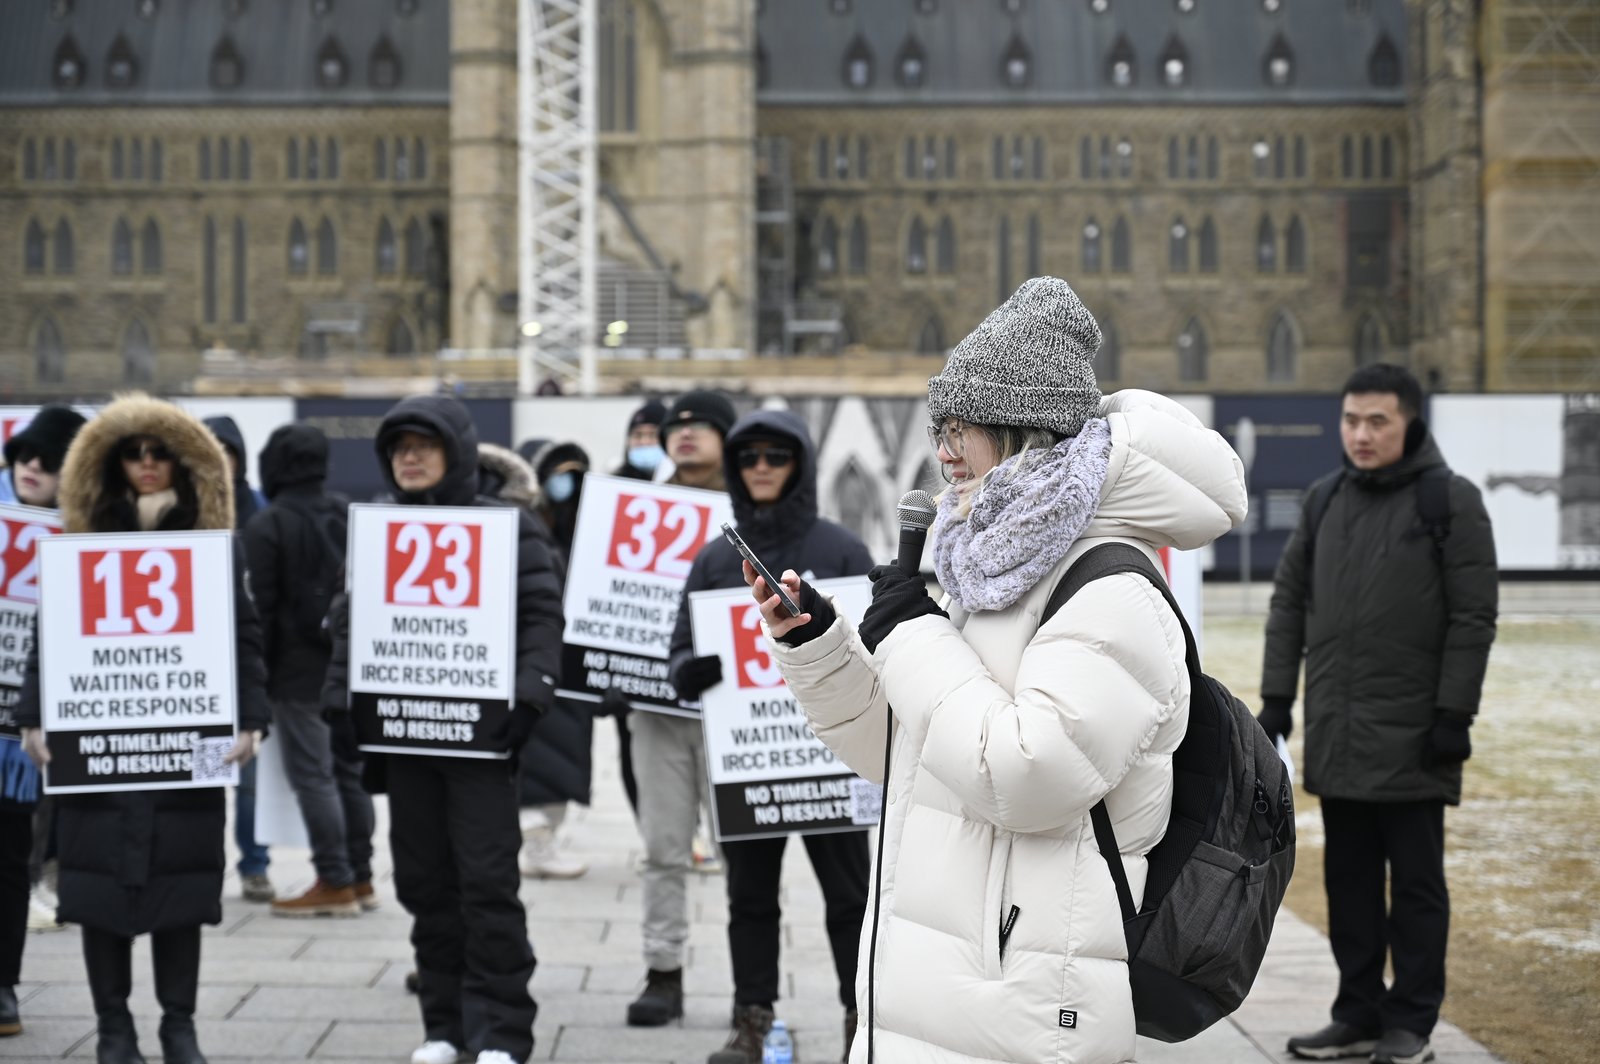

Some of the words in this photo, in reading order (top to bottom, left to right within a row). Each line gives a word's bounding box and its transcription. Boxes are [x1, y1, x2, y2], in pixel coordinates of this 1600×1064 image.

[616, 496, 700, 578] 32
[0, 517, 50, 598] 2
[393, 522, 472, 607] 23
[94, 549, 179, 634] 13
[588, 598, 661, 624] WAITING
[391, 617, 468, 636] MONTHS
[571, 618, 610, 638] IRCC
[614, 624, 672, 649] RESPO
[92, 646, 183, 666] MONTHS
[372, 640, 446, 660] WAITING
[453, 644, 488, 662] FOR
[361, 664, 398, 683] IRCC
[402, 667, 498, 688] RESPONSE
[583, 650, 608, 670] NO
[608, 654, 669, 680] TIMELIN
[70, 673, 159, 692] WAITING
[167, 671, 206, 689] FOR
[586, 670, 611, 690] NO
[58, 700, 104, 718] IRCC
[109, 695, 220, 717] RESPONSE
[377, 698, 400, 717] NO
[402, 700, 481, 722] TIMELINES
[751, 699, 797, 719] MON
[383, 719, 405, 738] NO
[407, 721, 474, 742] RESULTS
[731, 724, 815, 746] WAITING
[79, 735, 106, 754] NO
[108, 731, 200, 753] TIMELINES
[87, 756, 114, 775] NO
[117, 752, 193, 774] RESULTS
[722, 752, 766, 771] IRCC
[769, 747, 834, 770] RESPO
[744, 785, 771, 805] NO
[754, 805, 780, 825] NO
